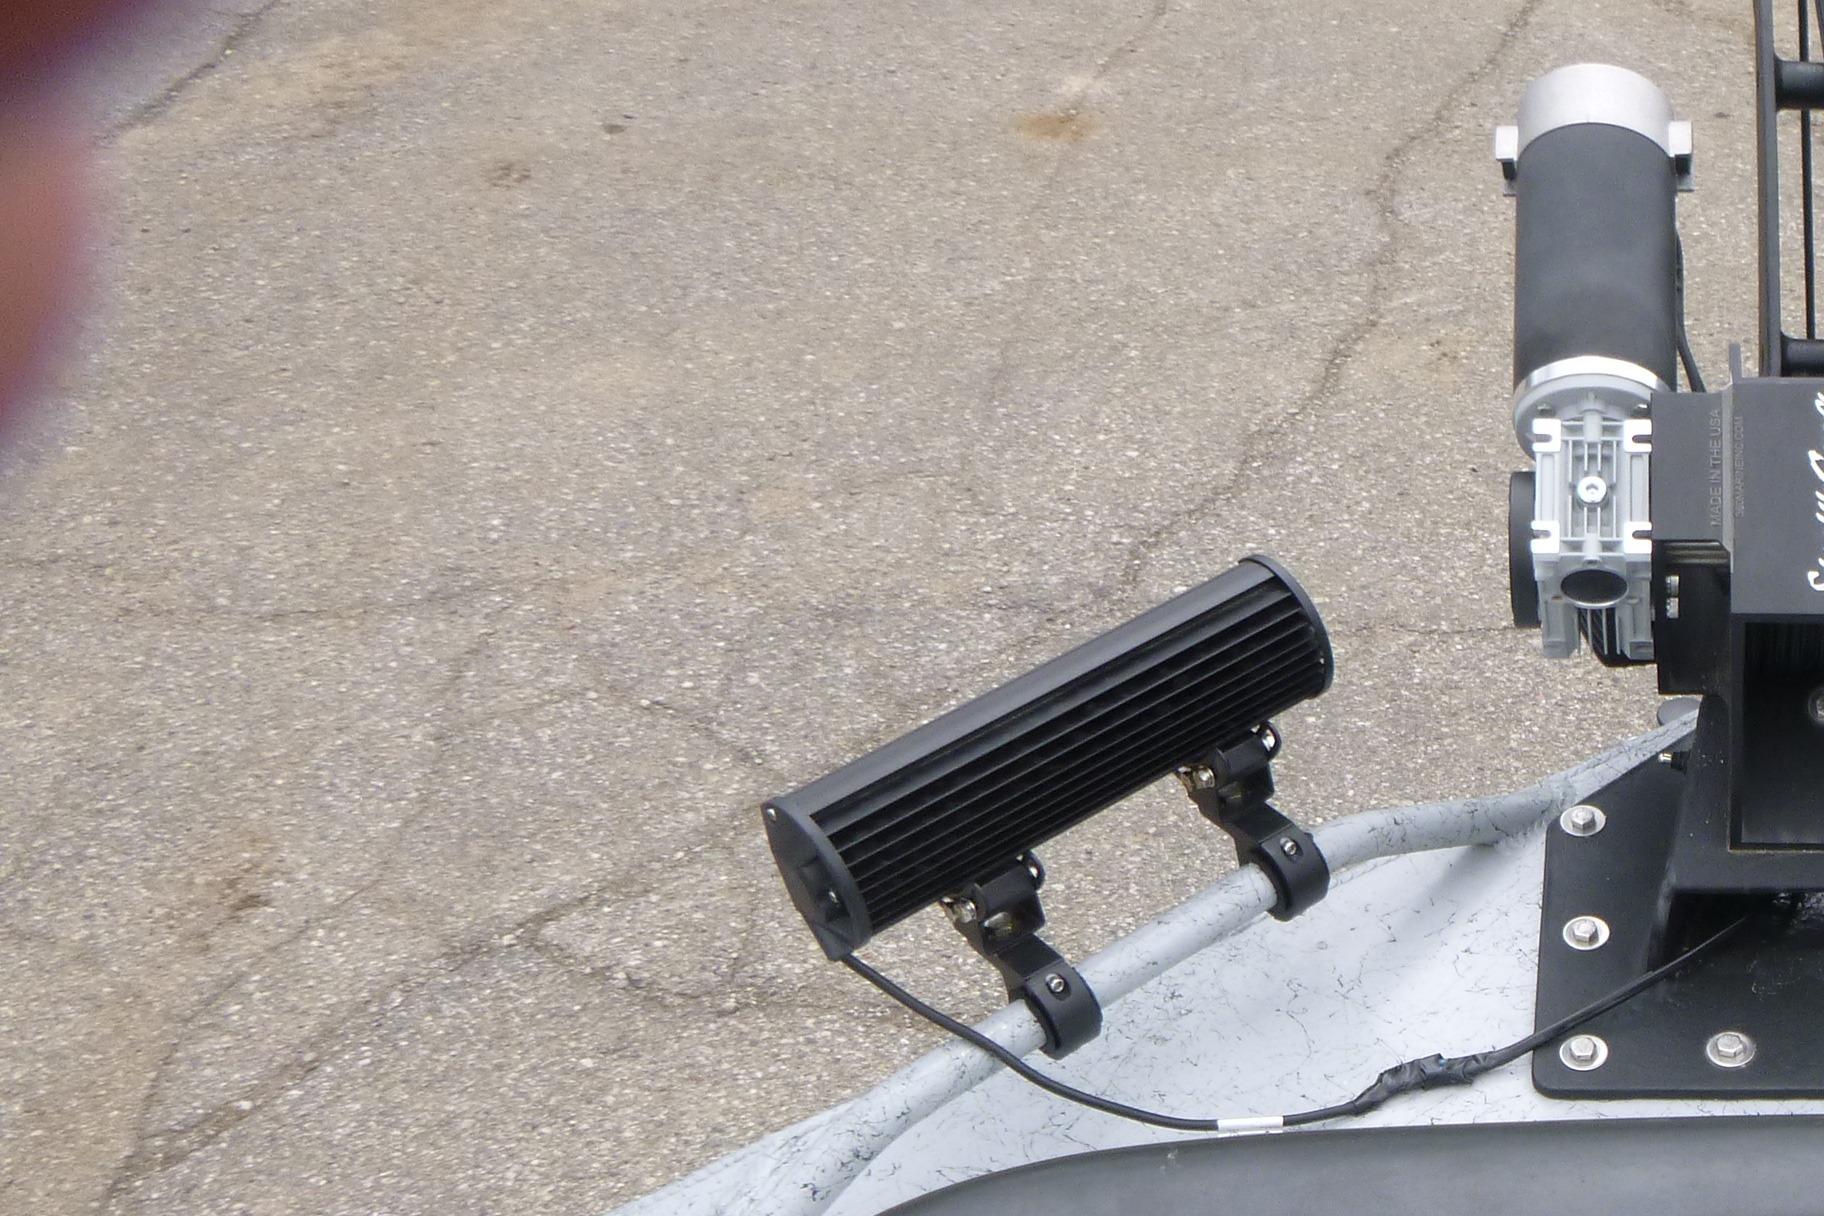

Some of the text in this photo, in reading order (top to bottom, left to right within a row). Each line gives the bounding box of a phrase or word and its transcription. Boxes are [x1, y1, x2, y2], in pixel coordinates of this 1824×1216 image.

[1709, 408, 1721, 527] MADE IN THE USA
